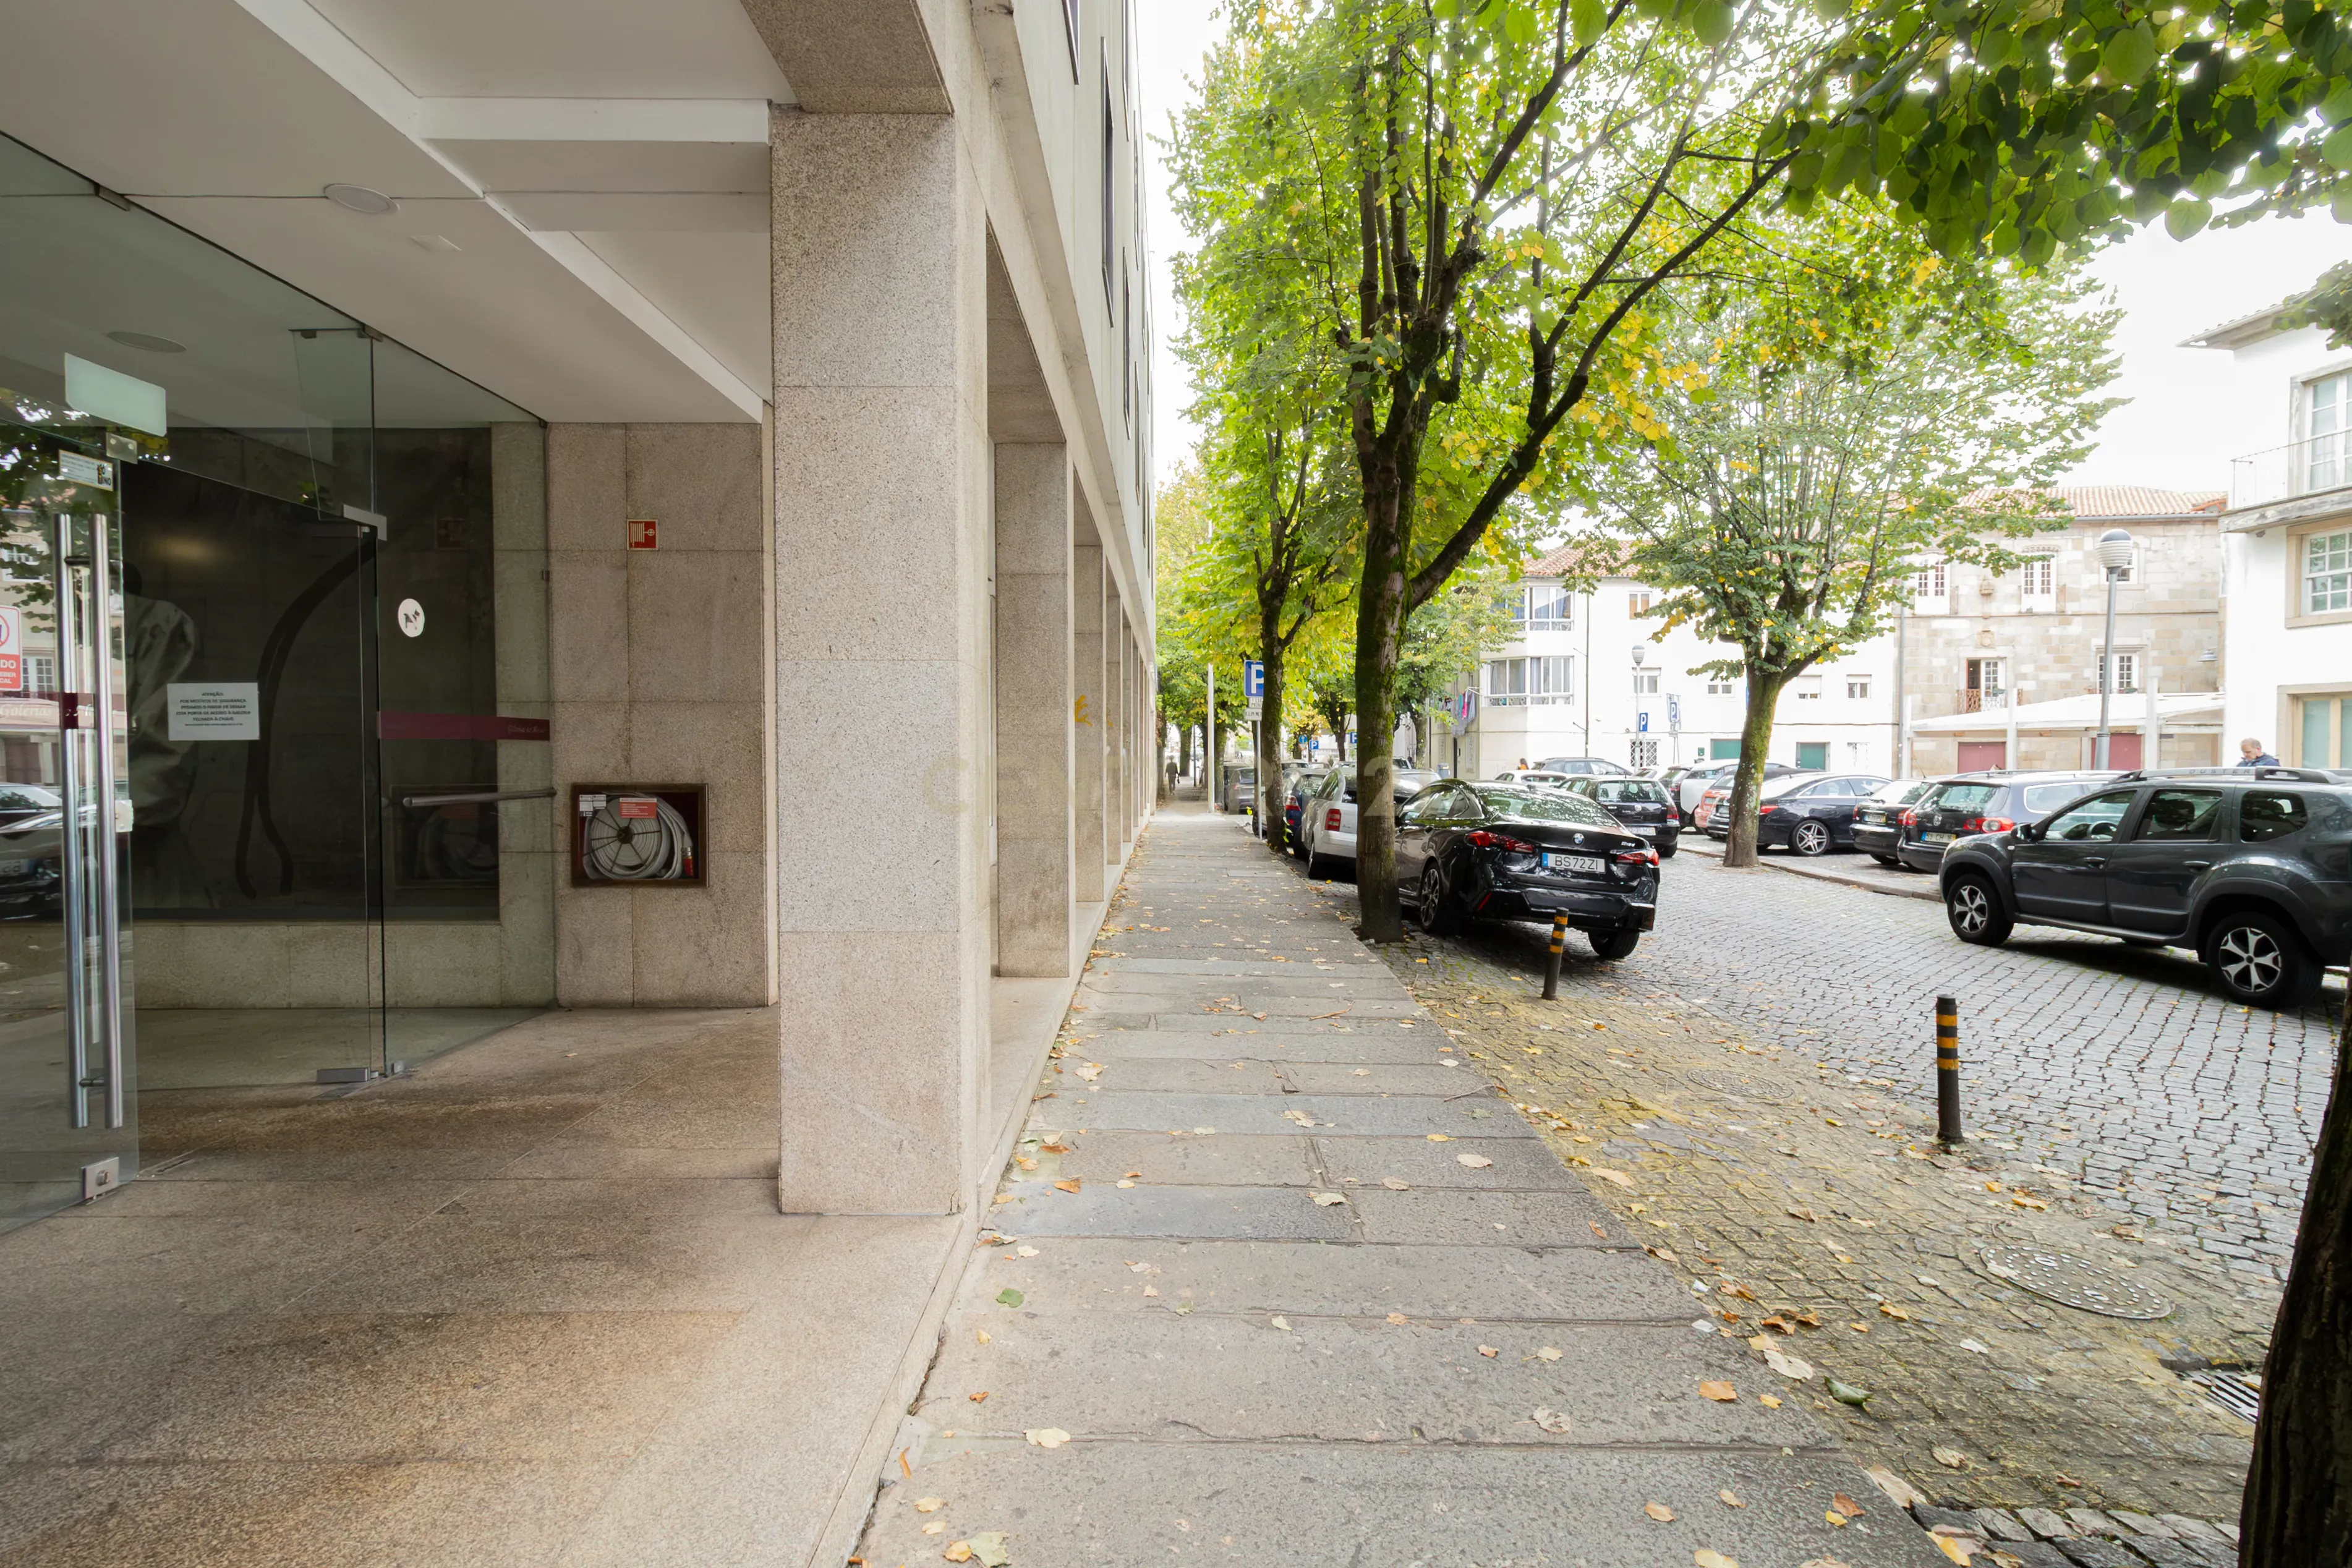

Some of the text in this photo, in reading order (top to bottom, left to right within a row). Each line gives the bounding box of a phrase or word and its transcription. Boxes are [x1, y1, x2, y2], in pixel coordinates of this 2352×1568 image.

[1251, 665, 1264, 694] P
[1640, 714, 1647, 731] P
[1311, 741, 1318, 749] P
[1555, 855, 1598, 871] BS72ZI
